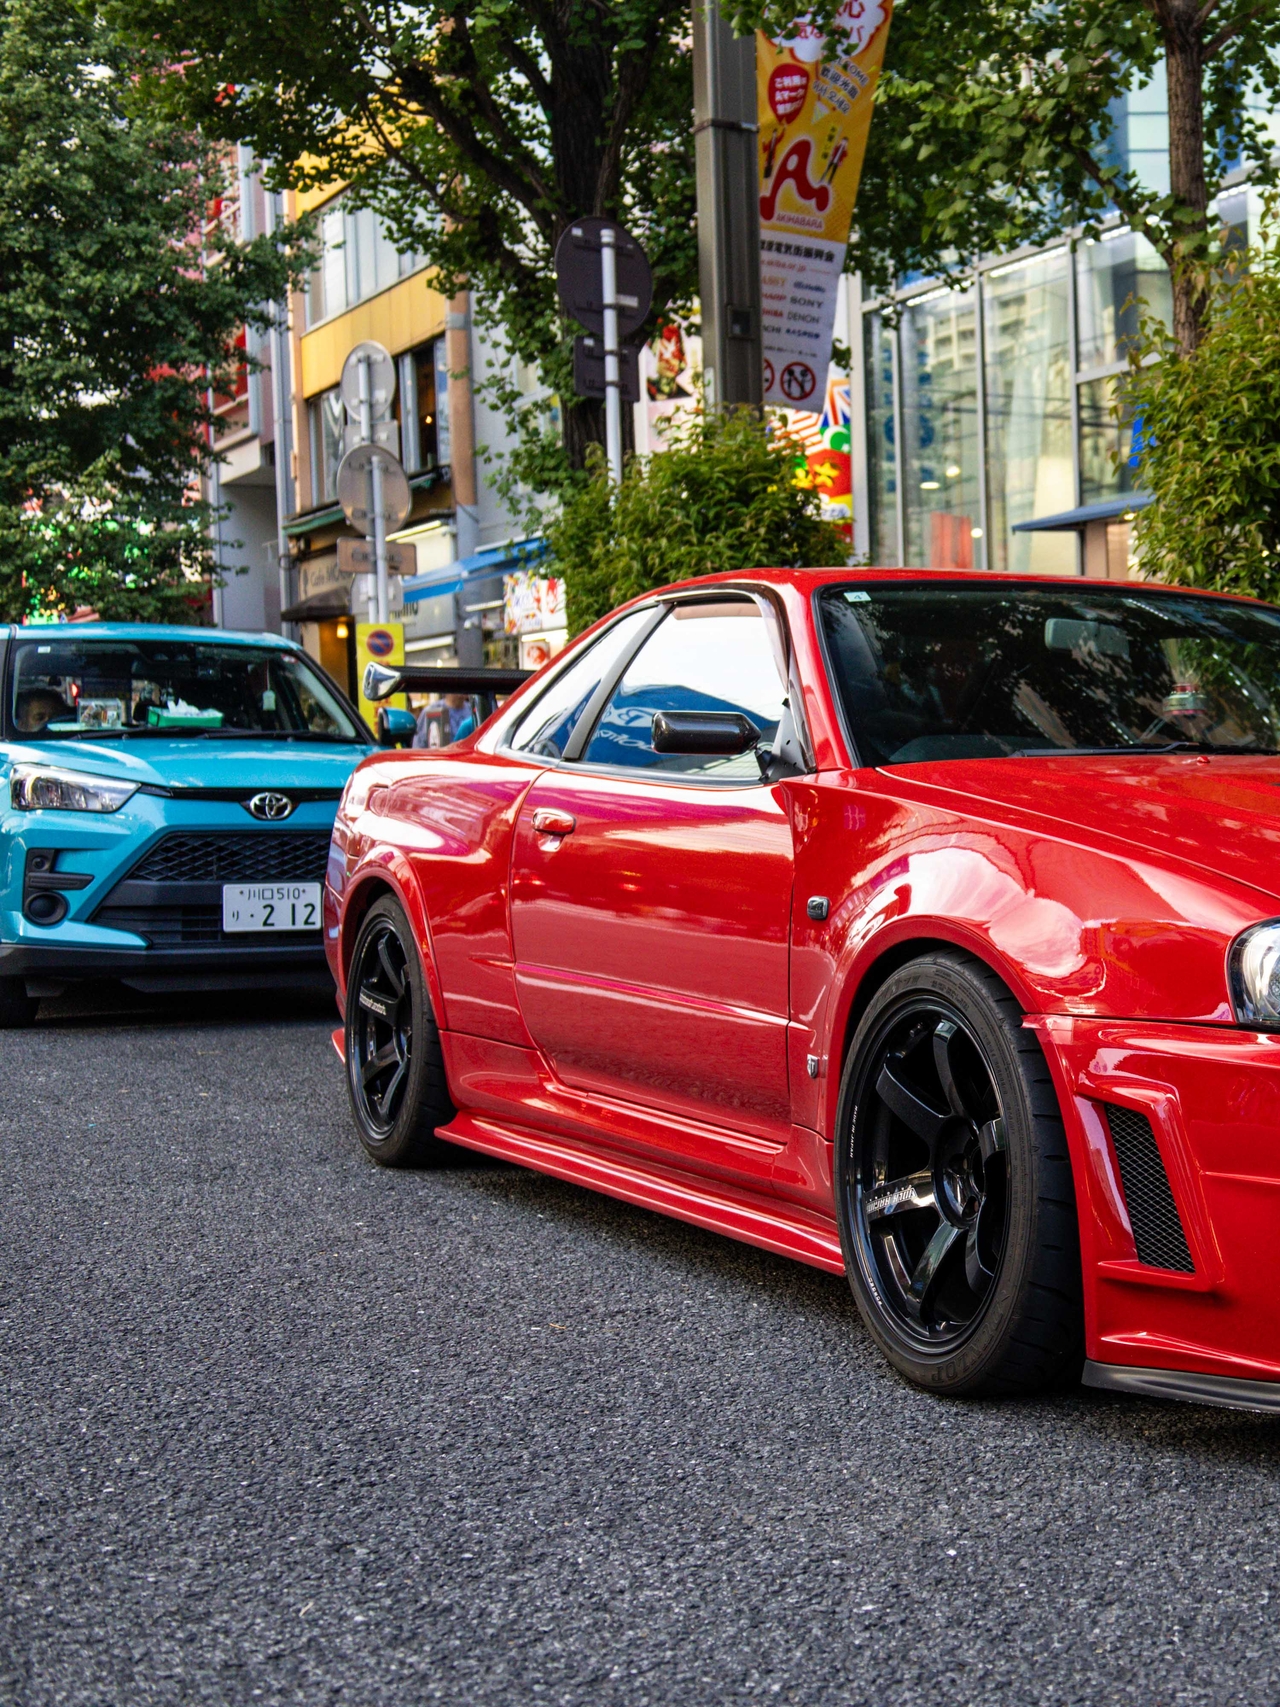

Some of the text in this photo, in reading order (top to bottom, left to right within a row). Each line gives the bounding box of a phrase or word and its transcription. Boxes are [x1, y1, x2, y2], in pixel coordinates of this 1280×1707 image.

[776, 213, 823, 229] AKIHABARA
[790, 296, 823, 308] SONY
[787, 311, 821, 324] DENON
